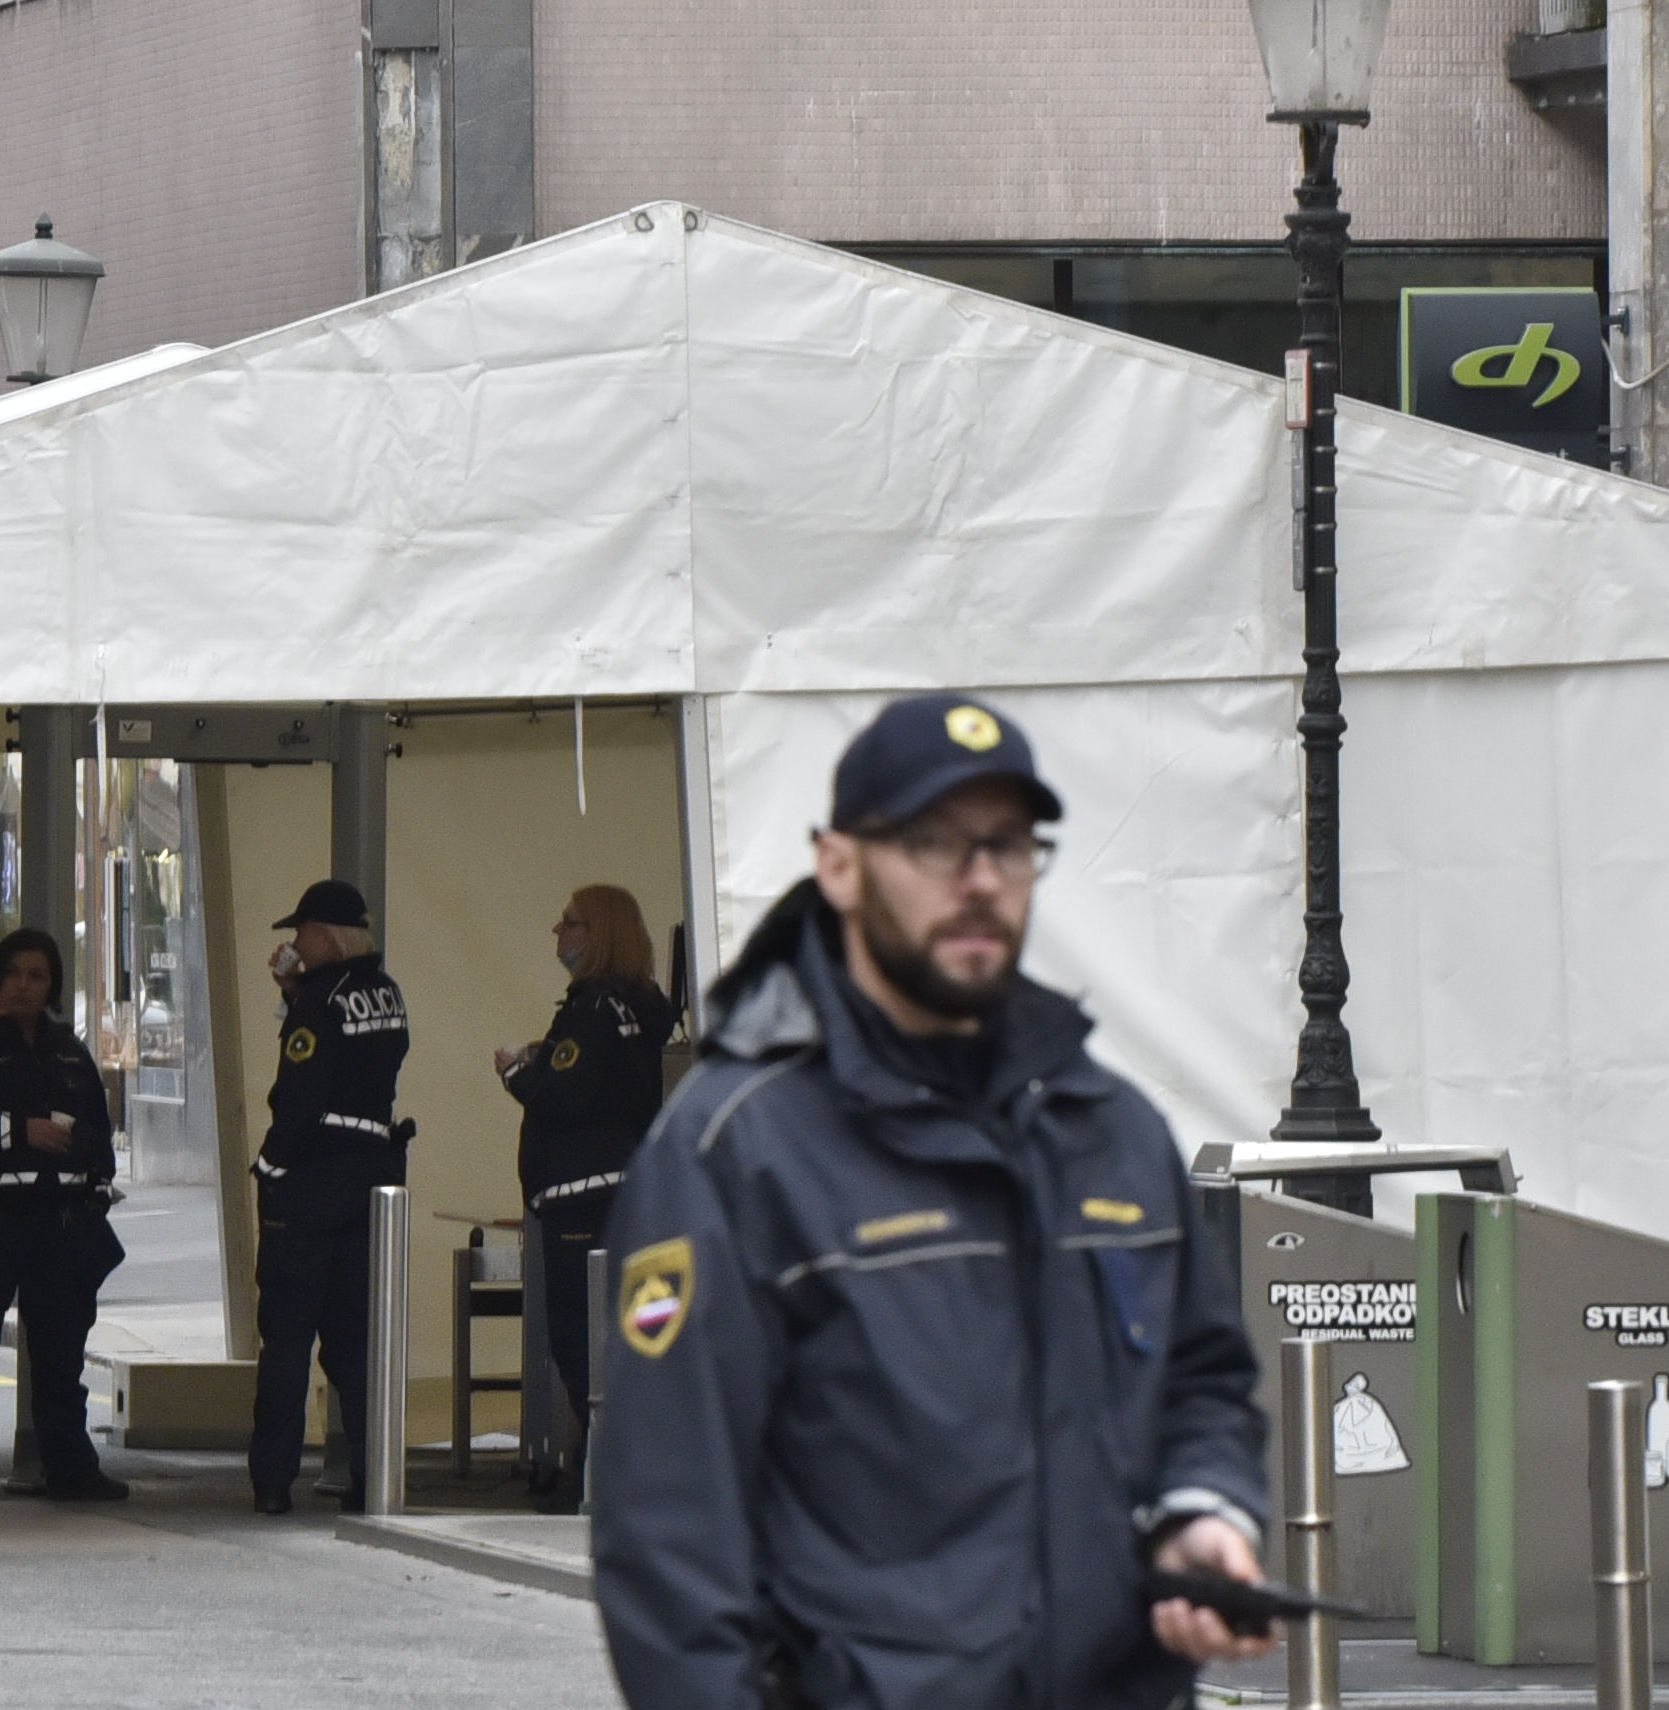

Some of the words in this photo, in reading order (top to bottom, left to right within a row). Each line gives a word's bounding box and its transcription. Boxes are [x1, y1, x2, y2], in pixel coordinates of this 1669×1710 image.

[1301, 1328, 1366, 1340] RESIDUAL
[1368, 1328, 1415, 1340] WASTE
[1617, 1332, 1666, 1345] GLASS
